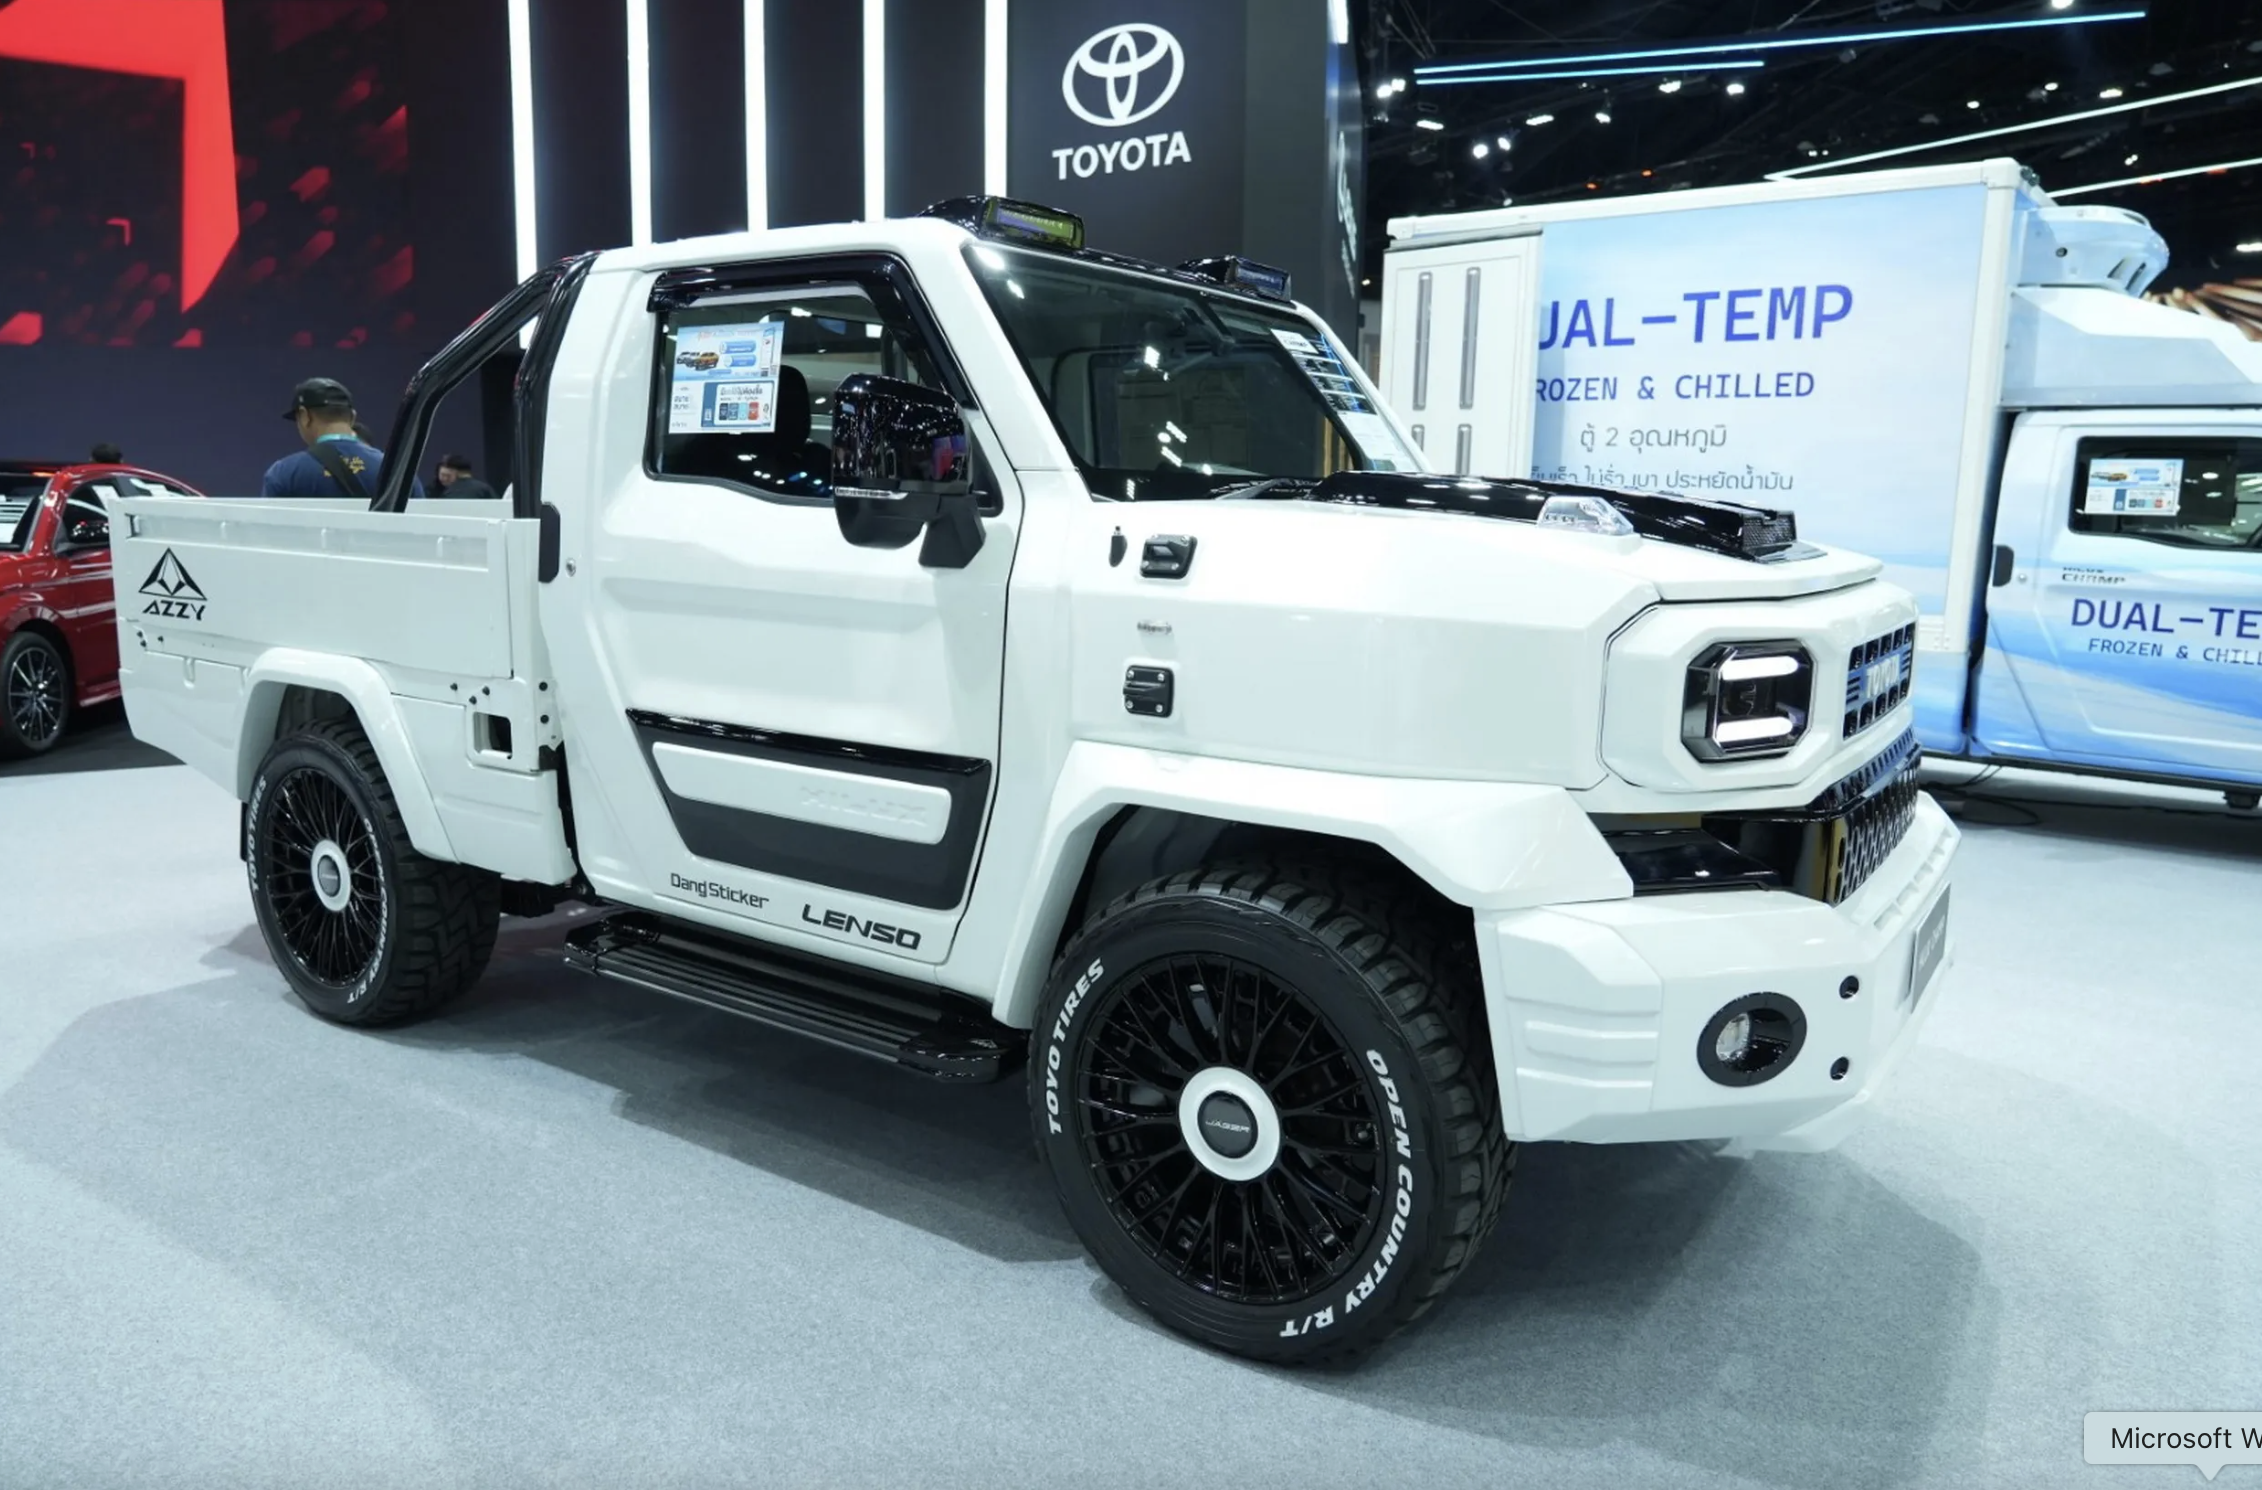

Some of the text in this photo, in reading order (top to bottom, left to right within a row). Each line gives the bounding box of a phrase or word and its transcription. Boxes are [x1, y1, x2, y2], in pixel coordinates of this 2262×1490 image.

[1052, 131, 1192, 180] TOYOTA
[1538, 284, 1853, 350] UAL-TEMP
[1535, 372, 1815, 402] ROZEN & CHILLED
[1605, 426, 1619, 447] 2
[1629, 424, 1727, 454] อุณหภูมิ
[142, 600, 206, 621] AZZY
[2071, 598, 2262, 639] DUAL-TE
[2088, 638, 2163, 658] FROZEN
[2176, 645, 2189, 660] &
[802, 904, 921, 950] LENSO
[1046, 957, 1105, 1135] TOYO TIRES
[1279, 1049, 1413, 1338] OPEN COUNTRY R/T
